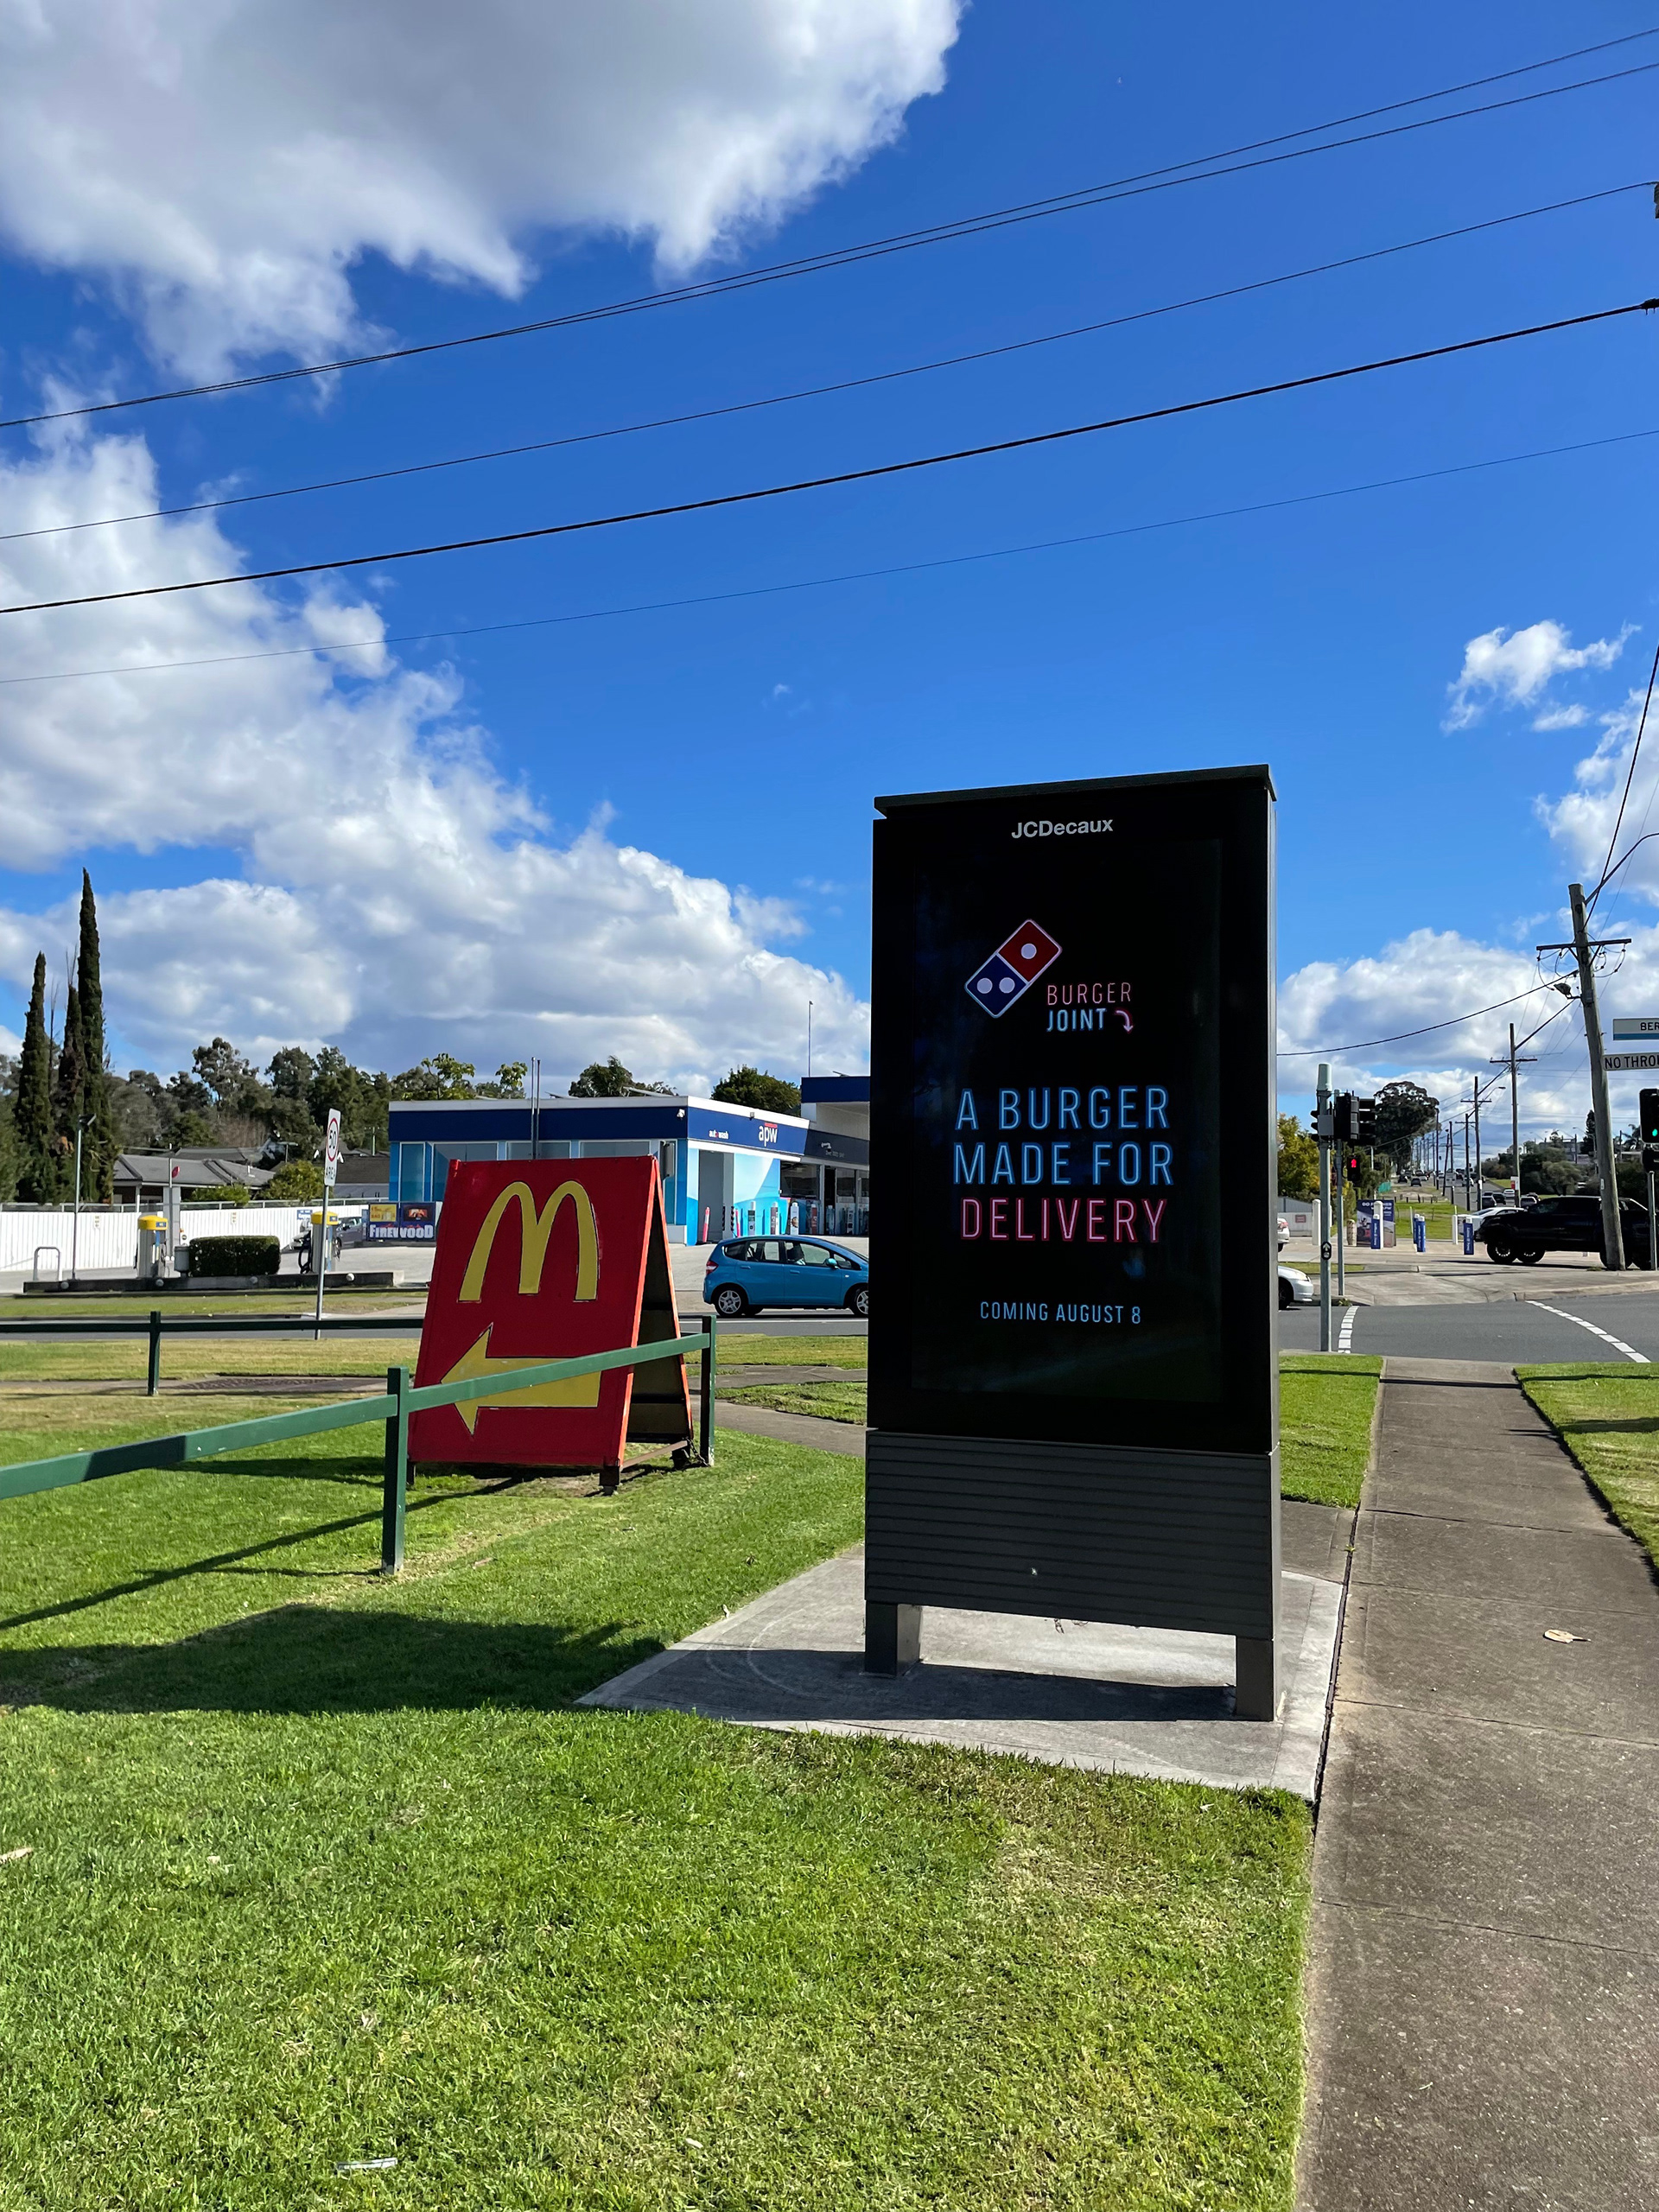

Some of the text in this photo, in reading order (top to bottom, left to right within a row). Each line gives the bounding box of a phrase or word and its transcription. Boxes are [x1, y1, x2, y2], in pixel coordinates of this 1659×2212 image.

[1011, 819, 1114, 839] JCDecaux
[1046, 982, 1132, 1006] BURGER
[1046, 1007, 1108, 1033] JOINT
[1604, 1056, 1622, 1069] NO
[955, 1085, 1171, 1130] A BURGER
[328, 1129, 337, 1149] 50
[759, 1125, 778, 1147] apw
[953, 1141, 1174, 1185] MADE FOR
[961, 1198, 1167, 1243] DELIVERY
[980, 1301, 1141, 1325] COMING AUGUST 8
